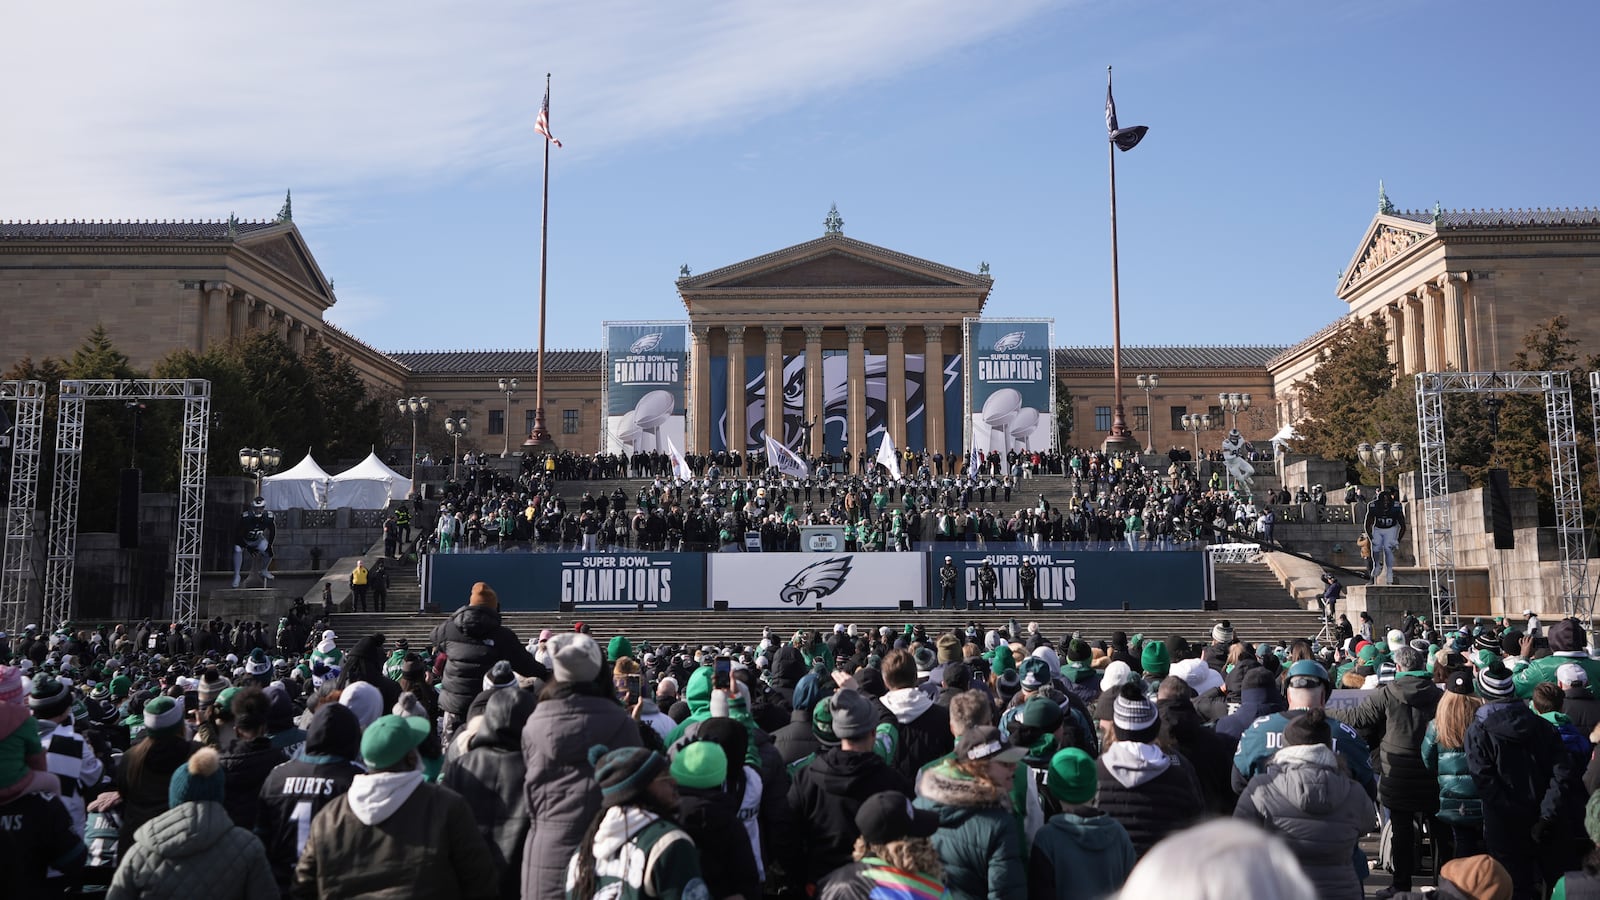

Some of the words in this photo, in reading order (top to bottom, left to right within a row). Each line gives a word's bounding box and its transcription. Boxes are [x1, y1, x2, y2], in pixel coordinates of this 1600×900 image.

[614, 362, 678, 383] CHAMPIONS
[978, 360, 1042, 380] CHAMPIONS
[582, 556, 616, 567] SUPER
[619, 556, 651, 567] BOWL
[985, 555, 1019, 565] SUPER
[561, 568, 671, 602] CHAMPIONS
[282, 776, 335, 796] HURTS
[290, 801, 313, 859] 1
